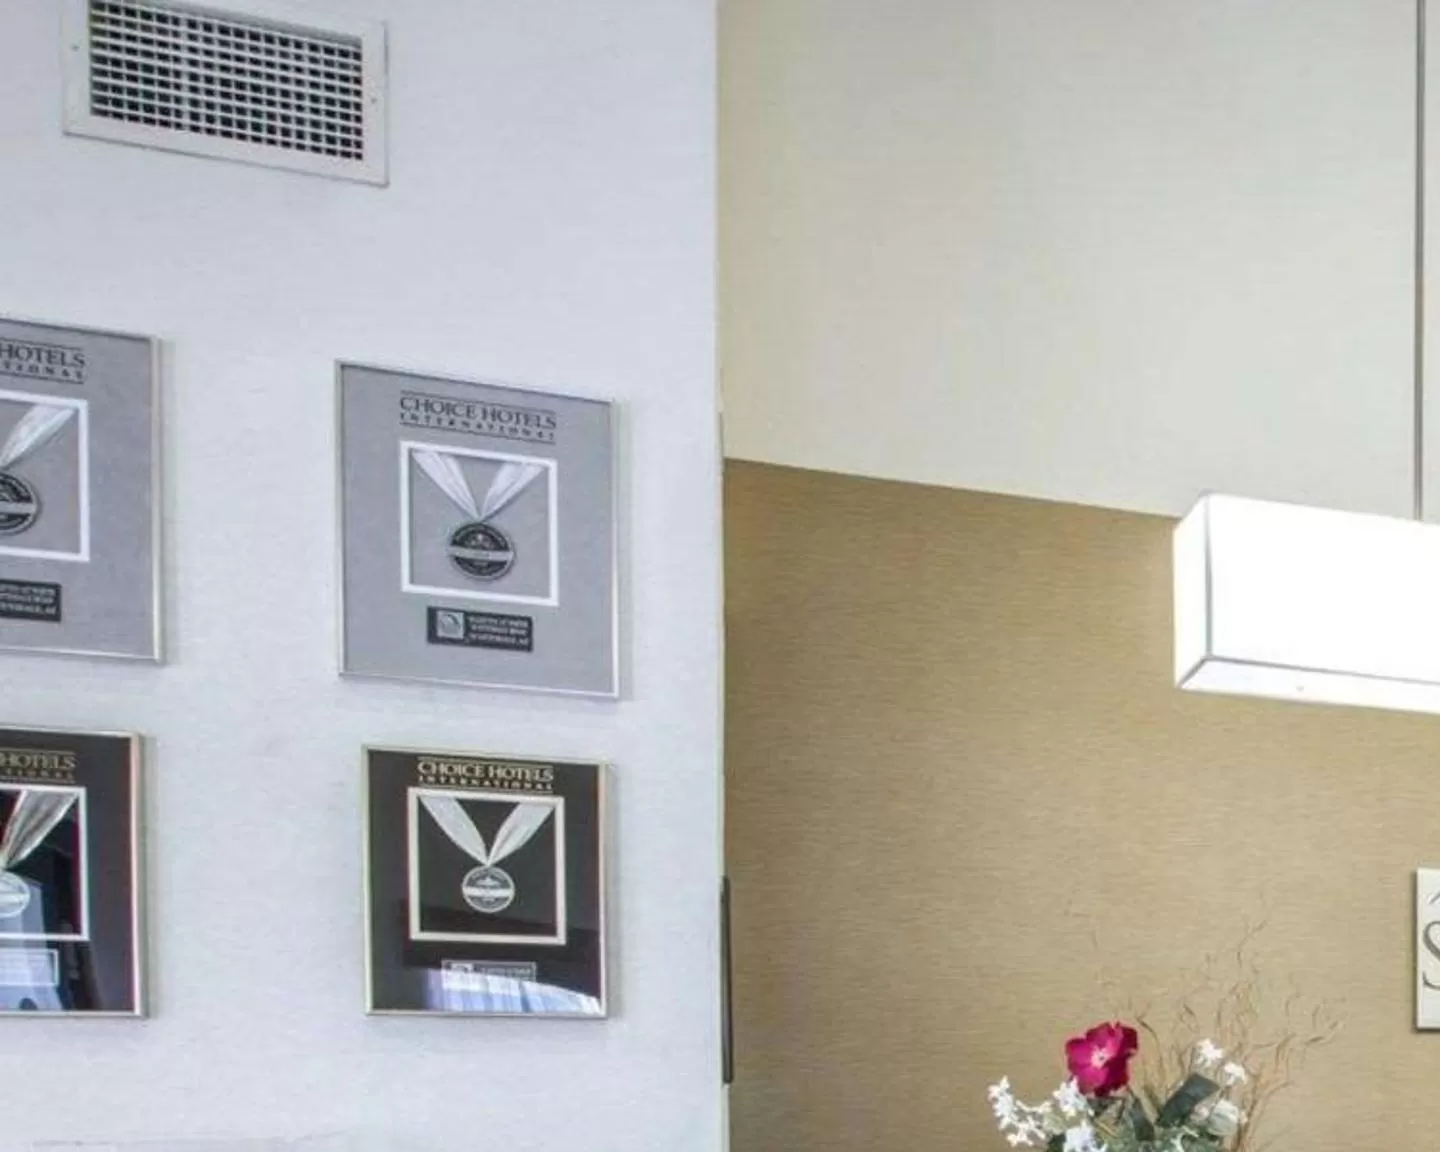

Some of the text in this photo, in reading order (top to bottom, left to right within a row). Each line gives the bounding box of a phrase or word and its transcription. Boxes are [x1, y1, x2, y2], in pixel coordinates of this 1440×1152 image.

[400, 397, 557, 429] CHOICE HOTELS
[418, 761, 554, 781] CHOICE HOTELS
